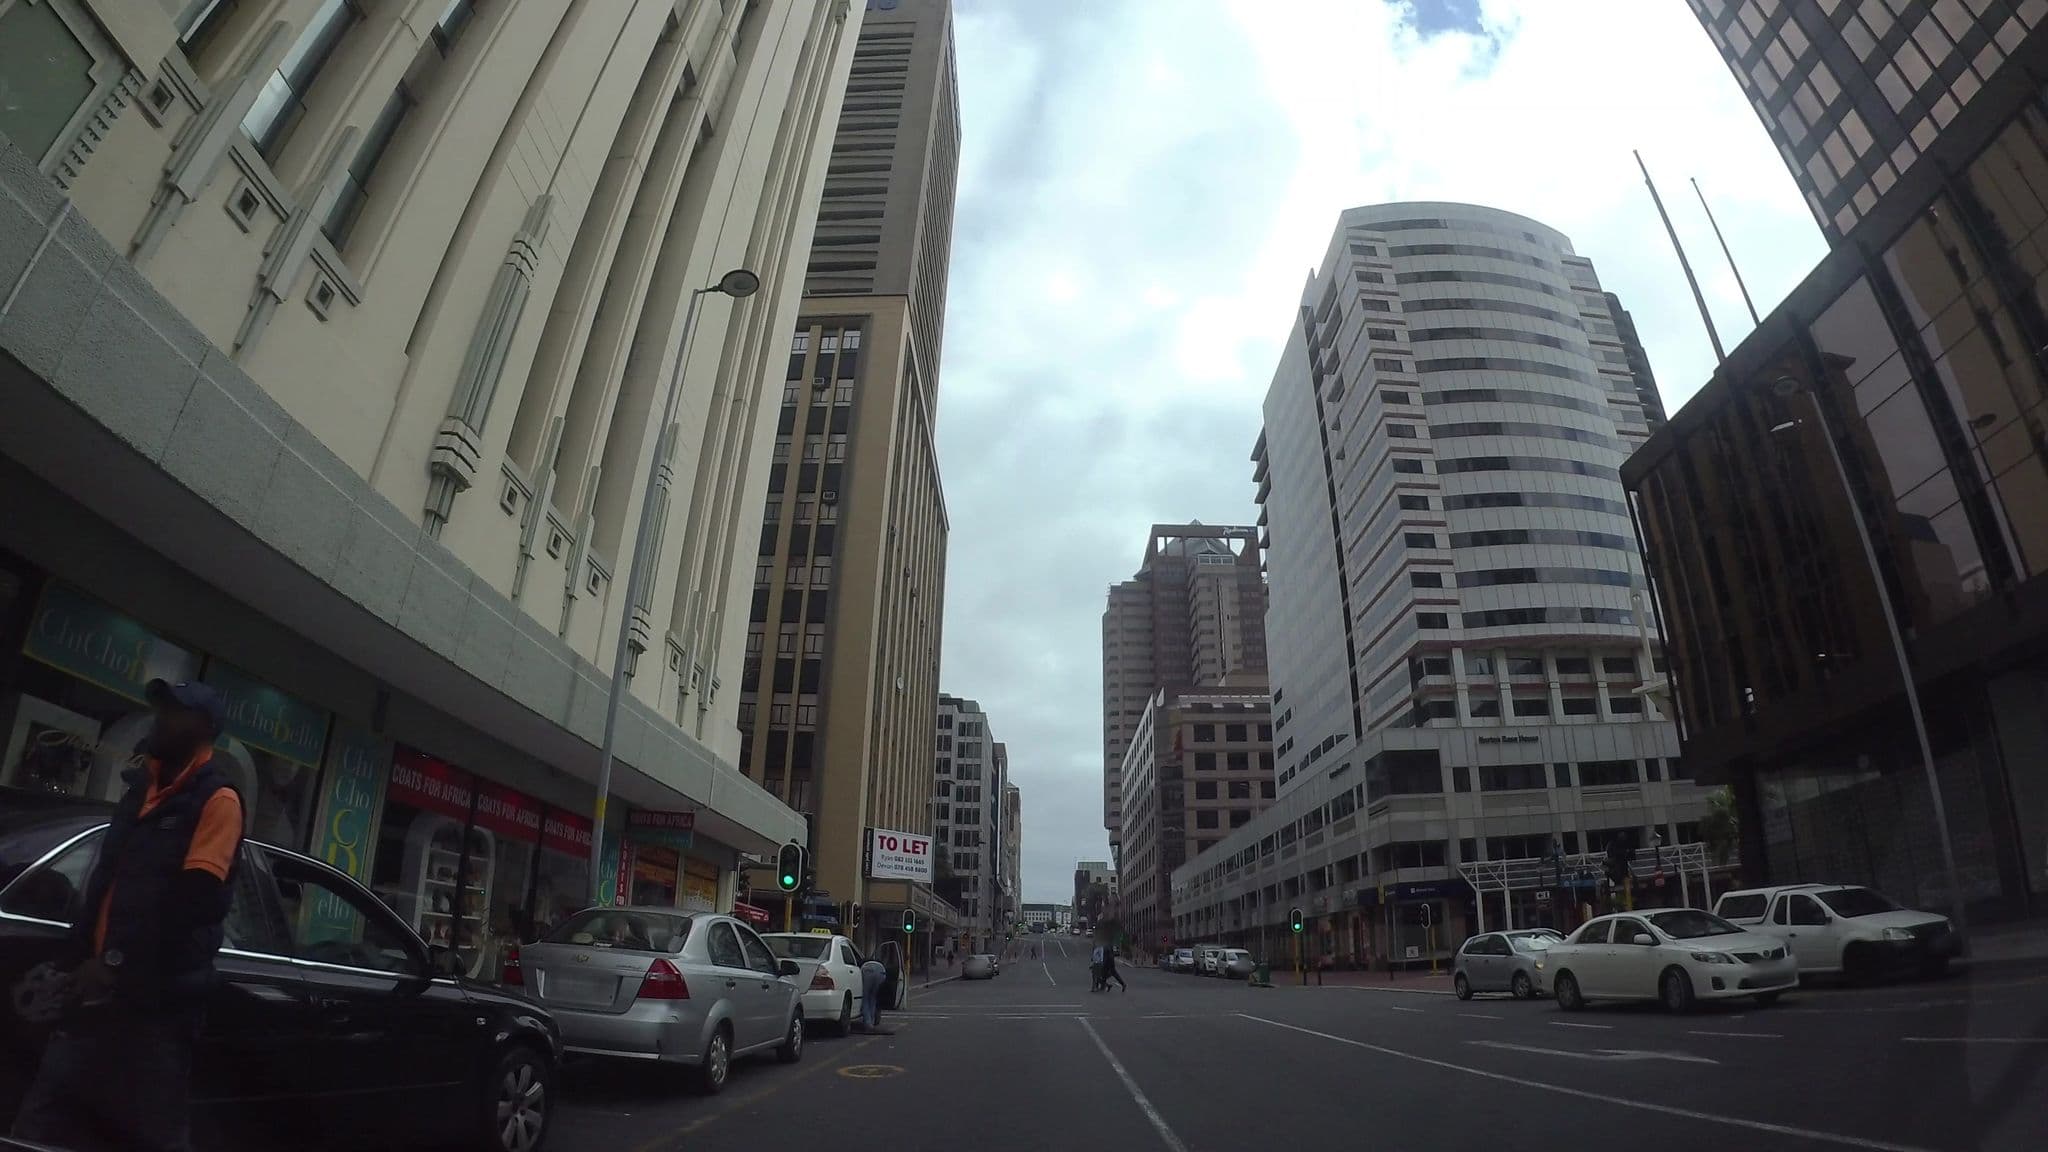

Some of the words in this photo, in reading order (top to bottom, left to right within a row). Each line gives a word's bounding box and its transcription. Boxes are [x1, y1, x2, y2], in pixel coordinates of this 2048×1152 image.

[392, 764, 422, 792] COATS
[422, 776, 441, 798] FOR
[441, 785, 472, 809] AFRICA
[477, 793, 502, 816] COATS
[502, 802, 516, 822] FOR
[516, 808, 540, 831] AFRICA
[545, 818, 564, 838] COATS
[564, 824, 576, 841] FOR
[878, 835, 898, 851] TO
[902, 839, 929, 855] LET
